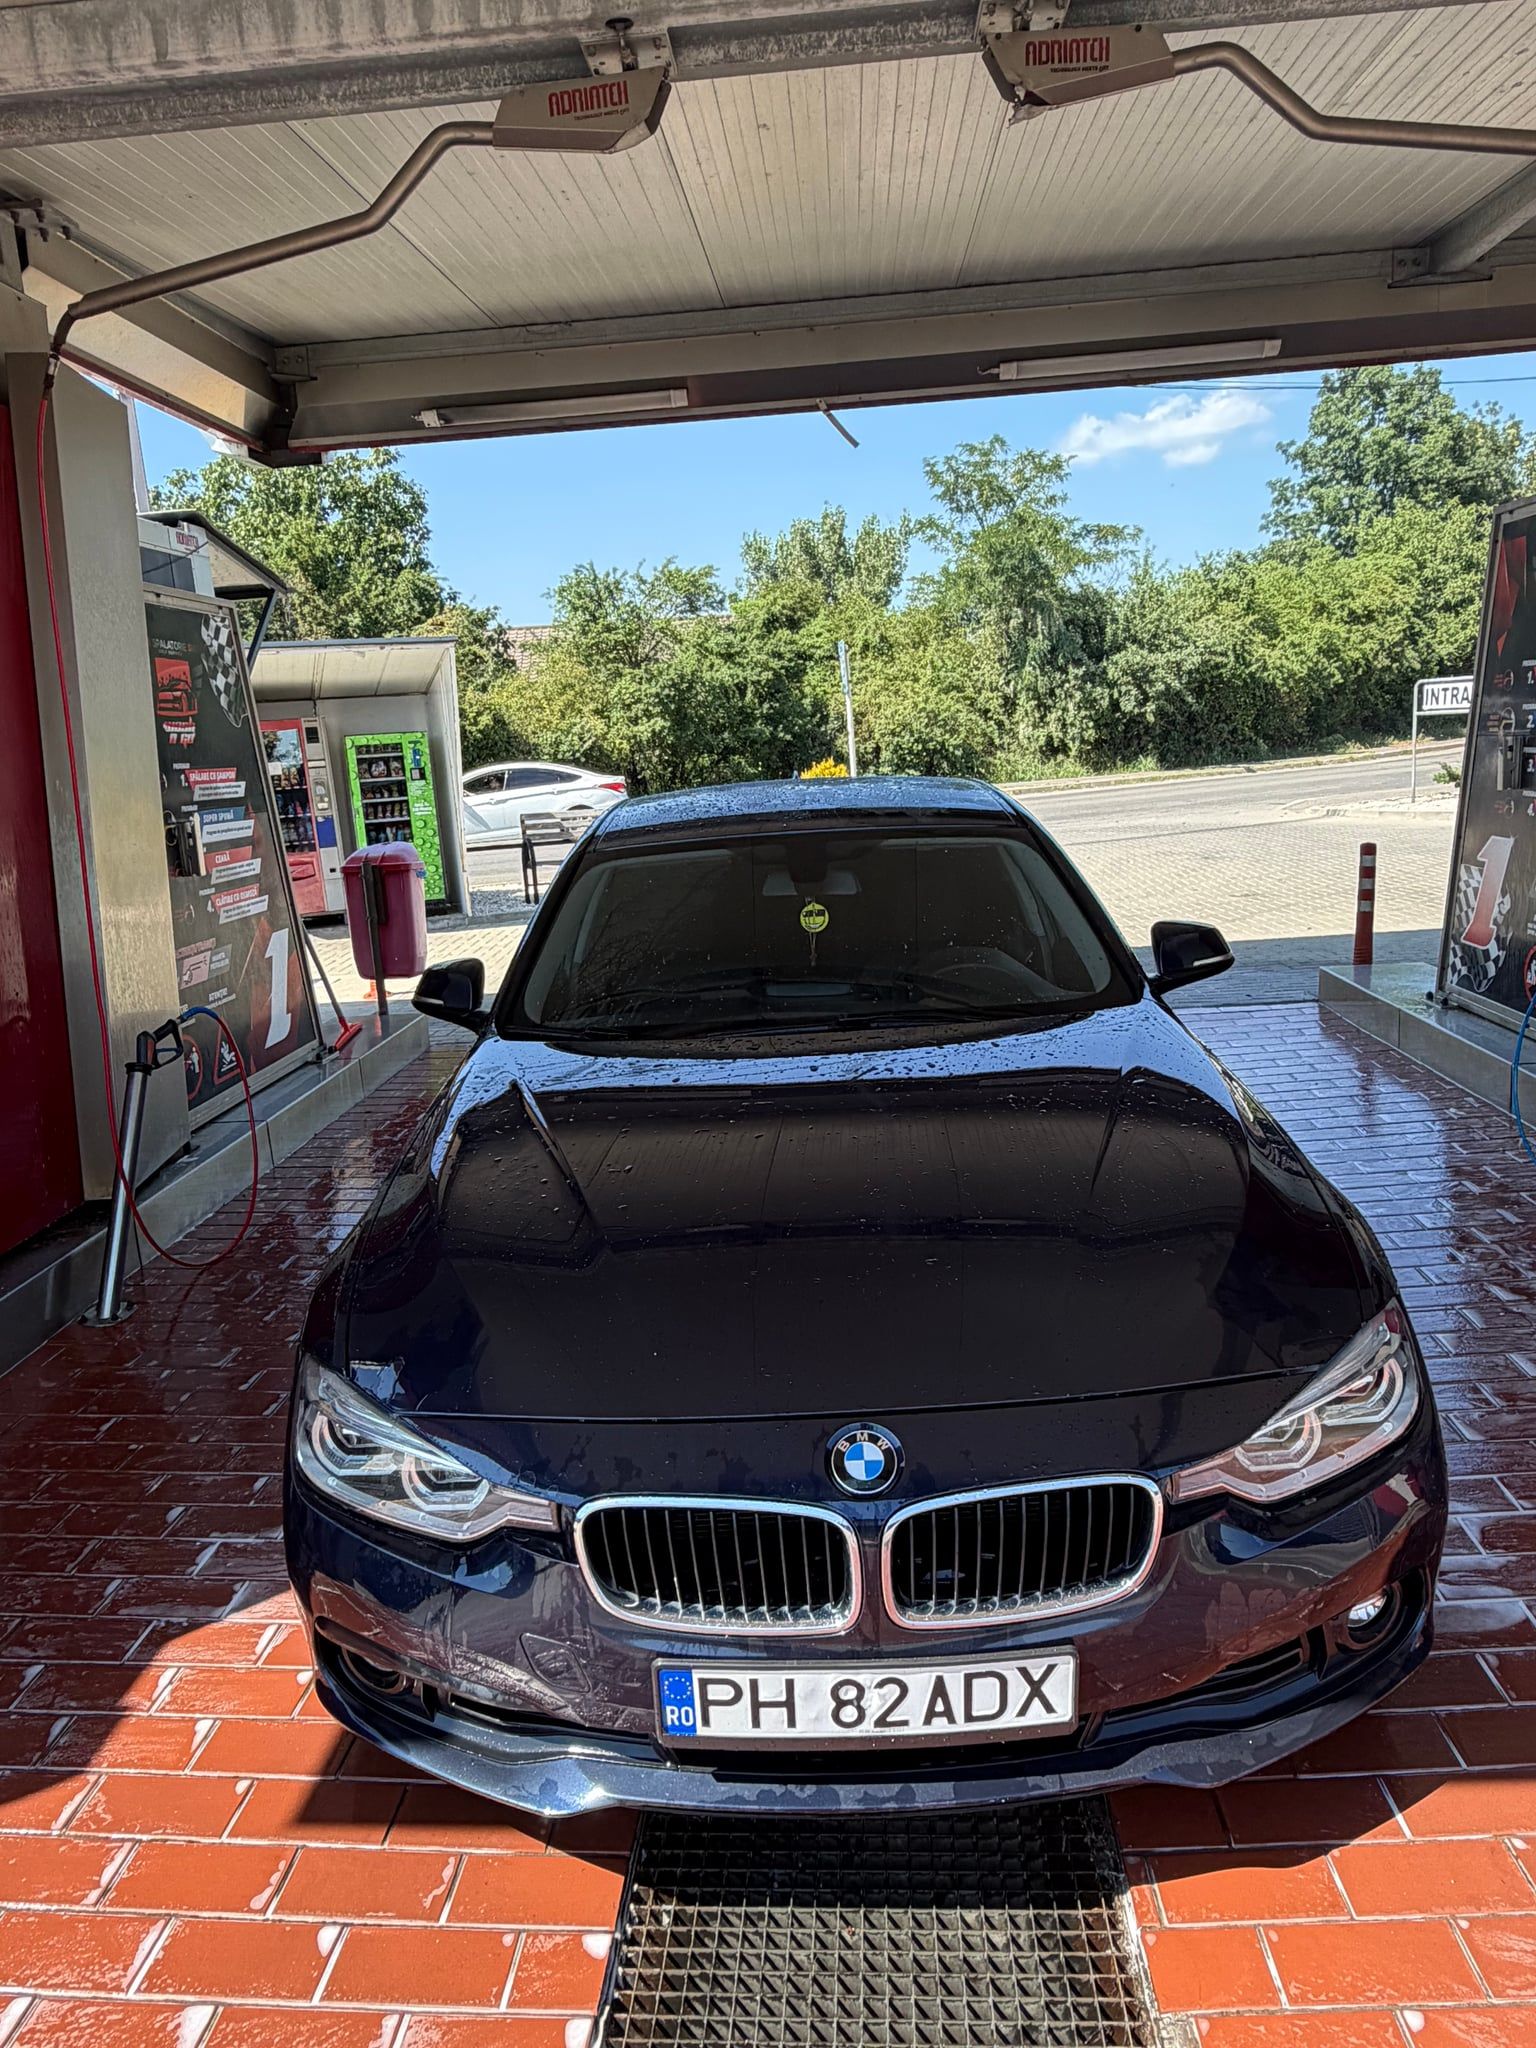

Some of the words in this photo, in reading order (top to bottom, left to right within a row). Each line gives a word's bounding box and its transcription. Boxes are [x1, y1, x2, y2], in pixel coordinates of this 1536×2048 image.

[1461, 835, 1515, 949] 1
[264, 928, 291, 1049] 1
[838, 1432, 890, 1452] BMW
[667, 1707, 695, 1727] RO
[699, 1678, 797, 1729] PH
[830, 1677, 910, 1729] 82
[922, 1663, 1060, 1727] ADX
